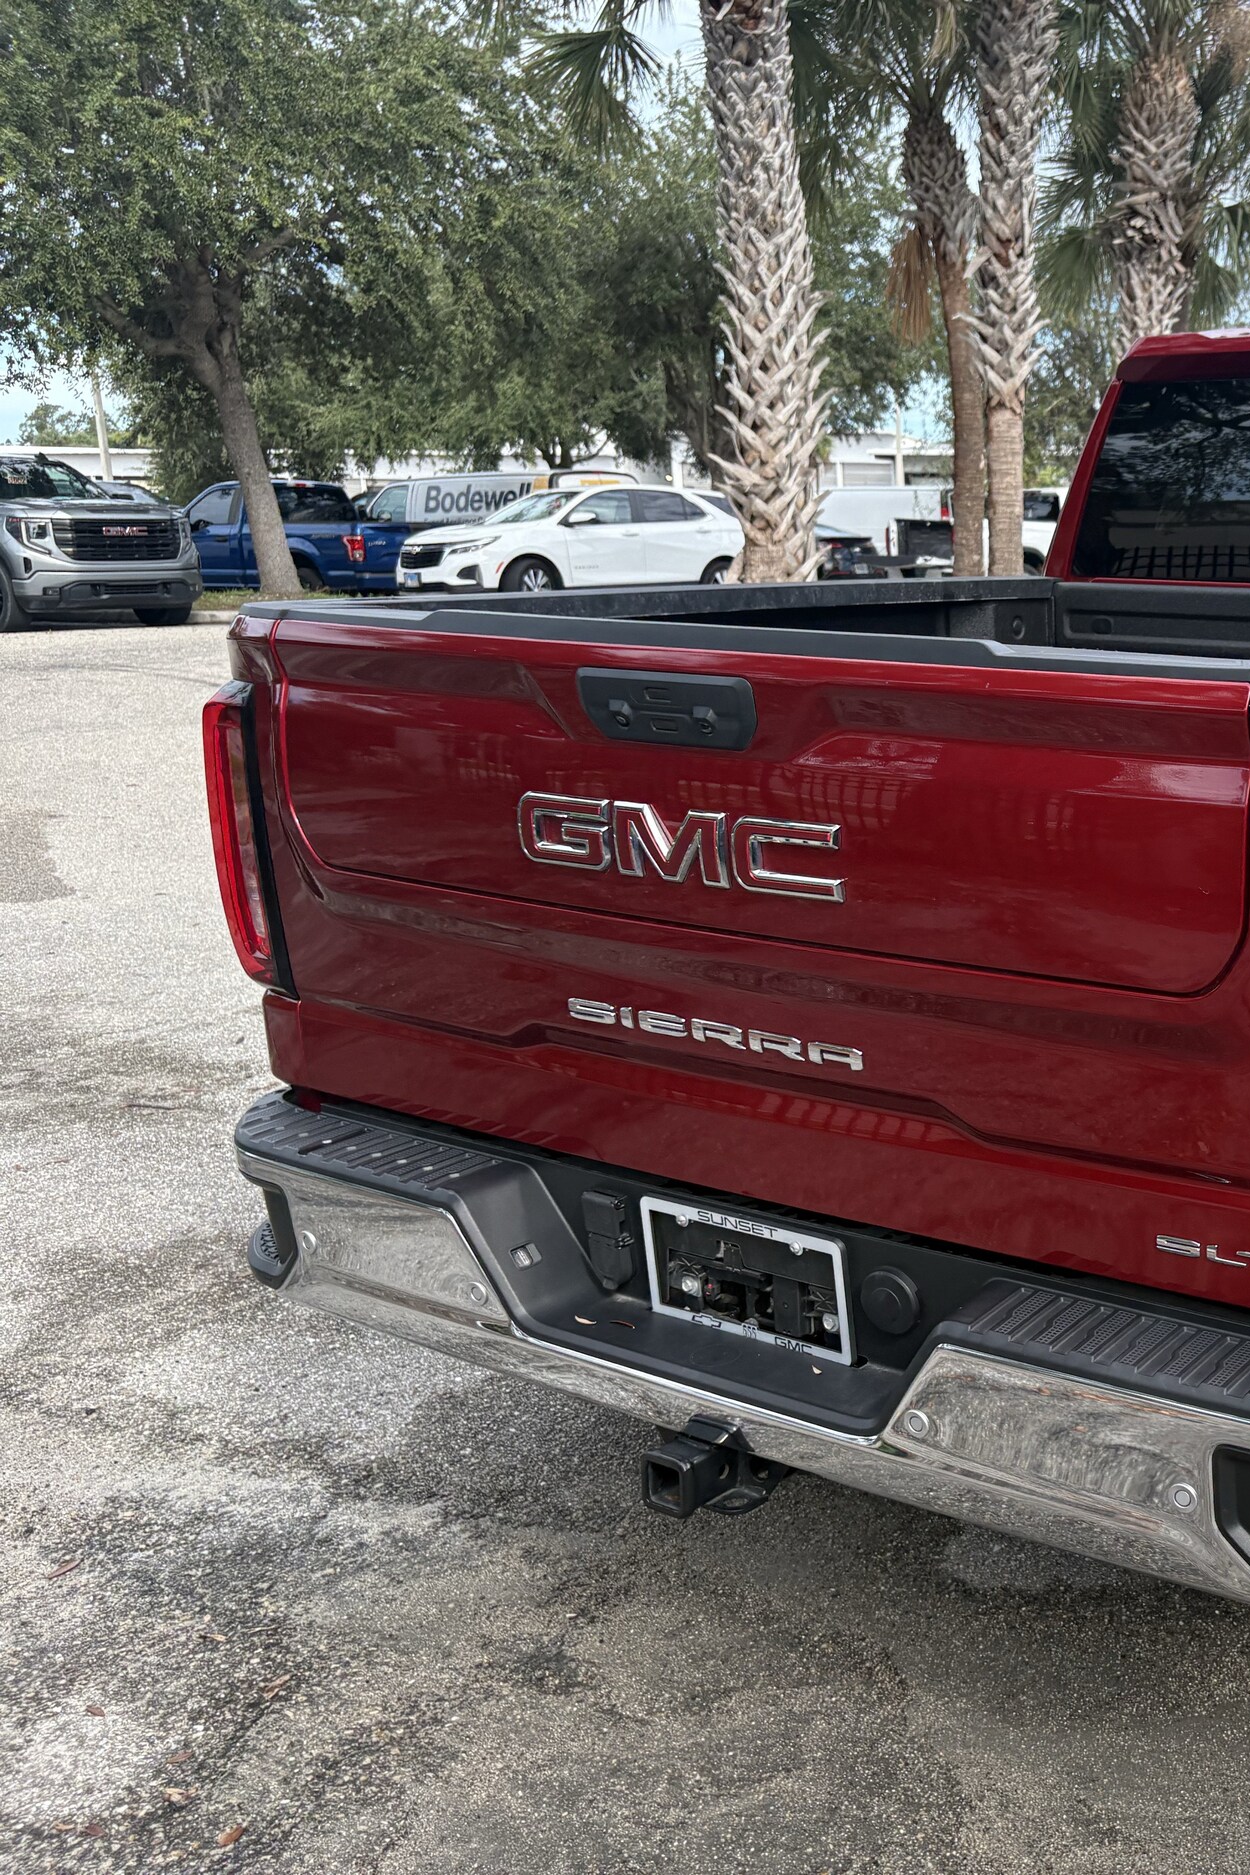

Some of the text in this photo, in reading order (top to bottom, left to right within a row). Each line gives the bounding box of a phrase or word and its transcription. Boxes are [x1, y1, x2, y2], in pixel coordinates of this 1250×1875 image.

[518, 790, 847, 903] GMC
[568, 997, 864, 1071] SIERRA
[697, 1210, 778, 1238] SUNSET
[774, 1336, 813, 1356] GMC
